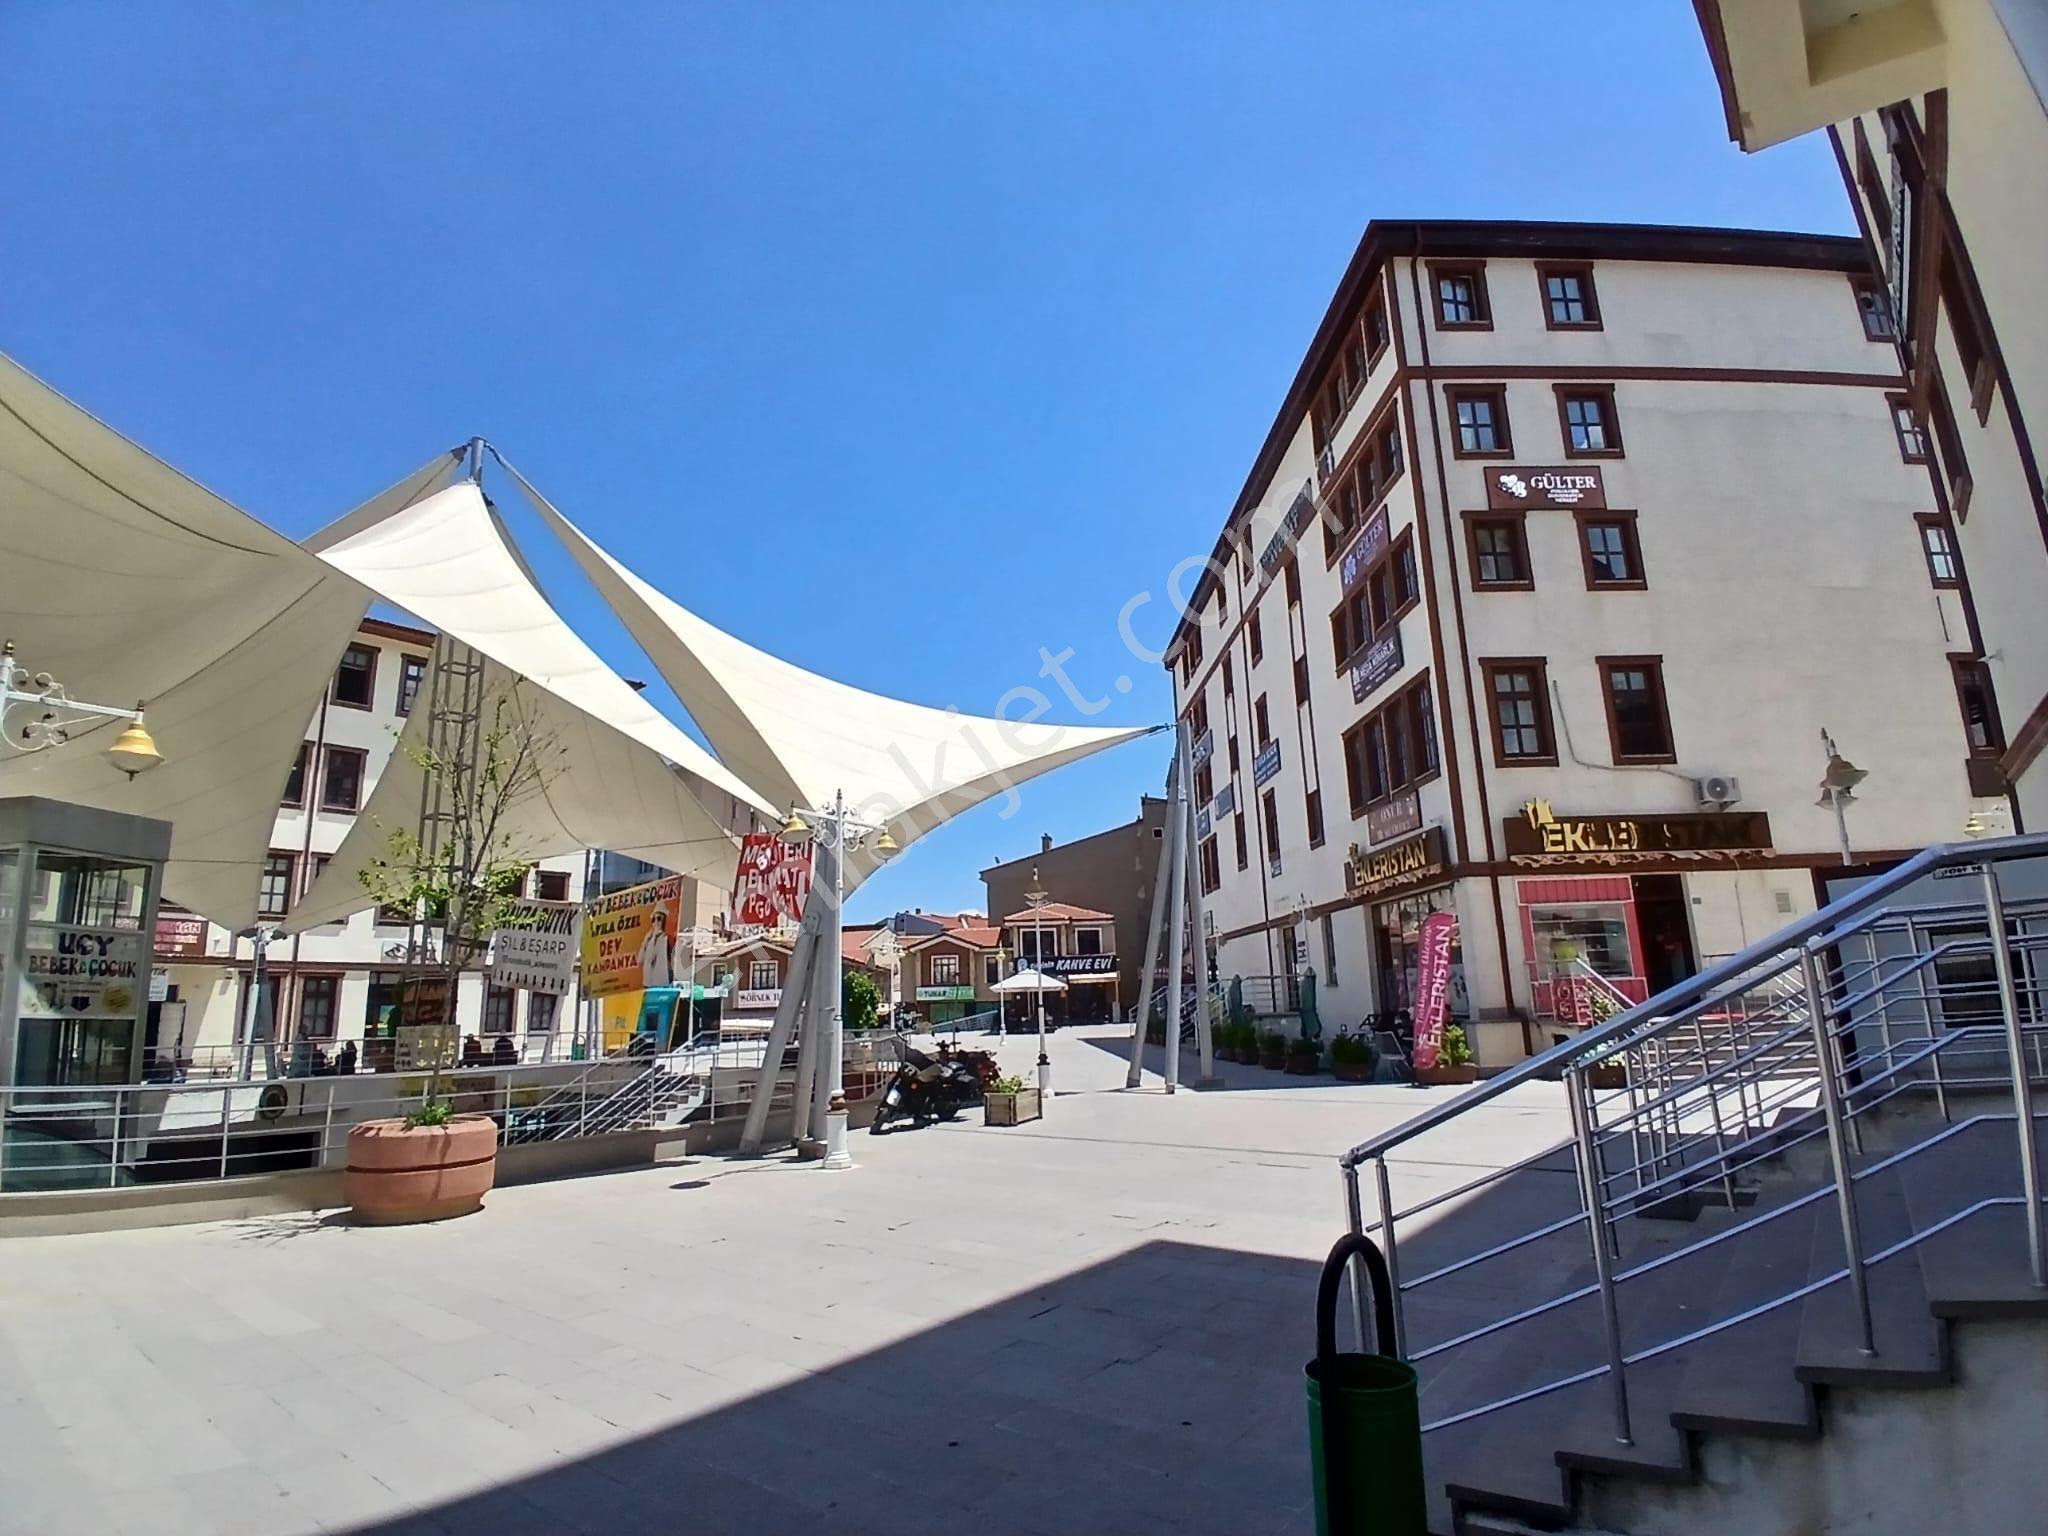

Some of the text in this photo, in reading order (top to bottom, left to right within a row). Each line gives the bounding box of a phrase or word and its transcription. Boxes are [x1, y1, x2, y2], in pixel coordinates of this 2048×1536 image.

[1531, 473, 1597, 489] GÜLTER
[617, 914, 641, 932] ÖZEL
[528, 938, 567, 957] EŞARP
[29, 954, 79, 976] BEBEK
[1056, 958, 1092, 971] KAHVE
